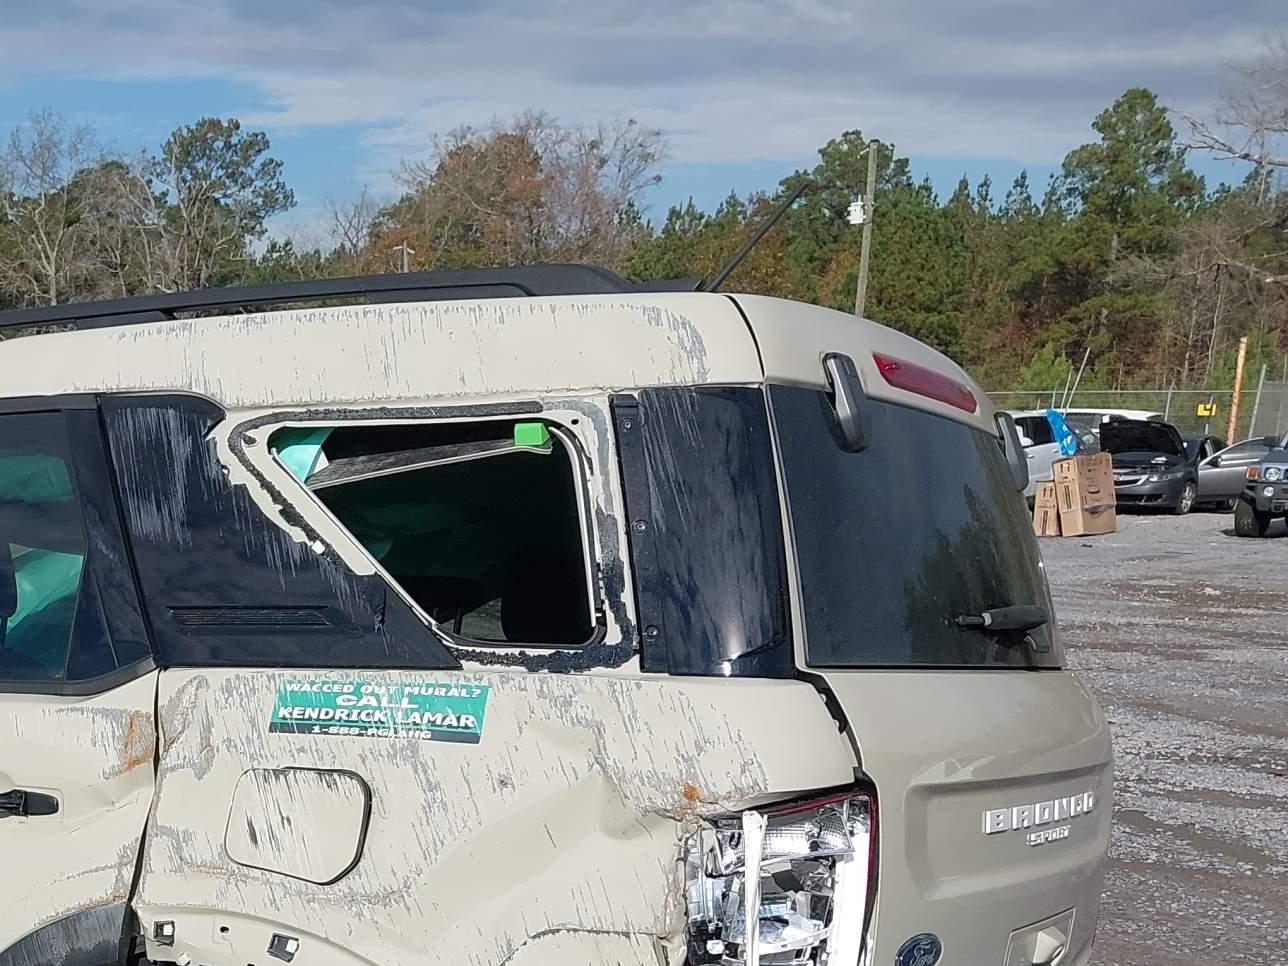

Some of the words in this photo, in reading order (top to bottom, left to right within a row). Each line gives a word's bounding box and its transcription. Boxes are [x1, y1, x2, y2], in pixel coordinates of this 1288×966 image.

[336, 694, 419, 709] CALL
[360, 685, 398, 694] OUT
[403, 686, 482, 698] MURAL?
[278, 706, 388, 723] KENDRICK
[395, 711, 475, 728] LAMAR
[983, 791, 1094, 834] BRONCO
[1027, 825, 1072, 846] SPORT
